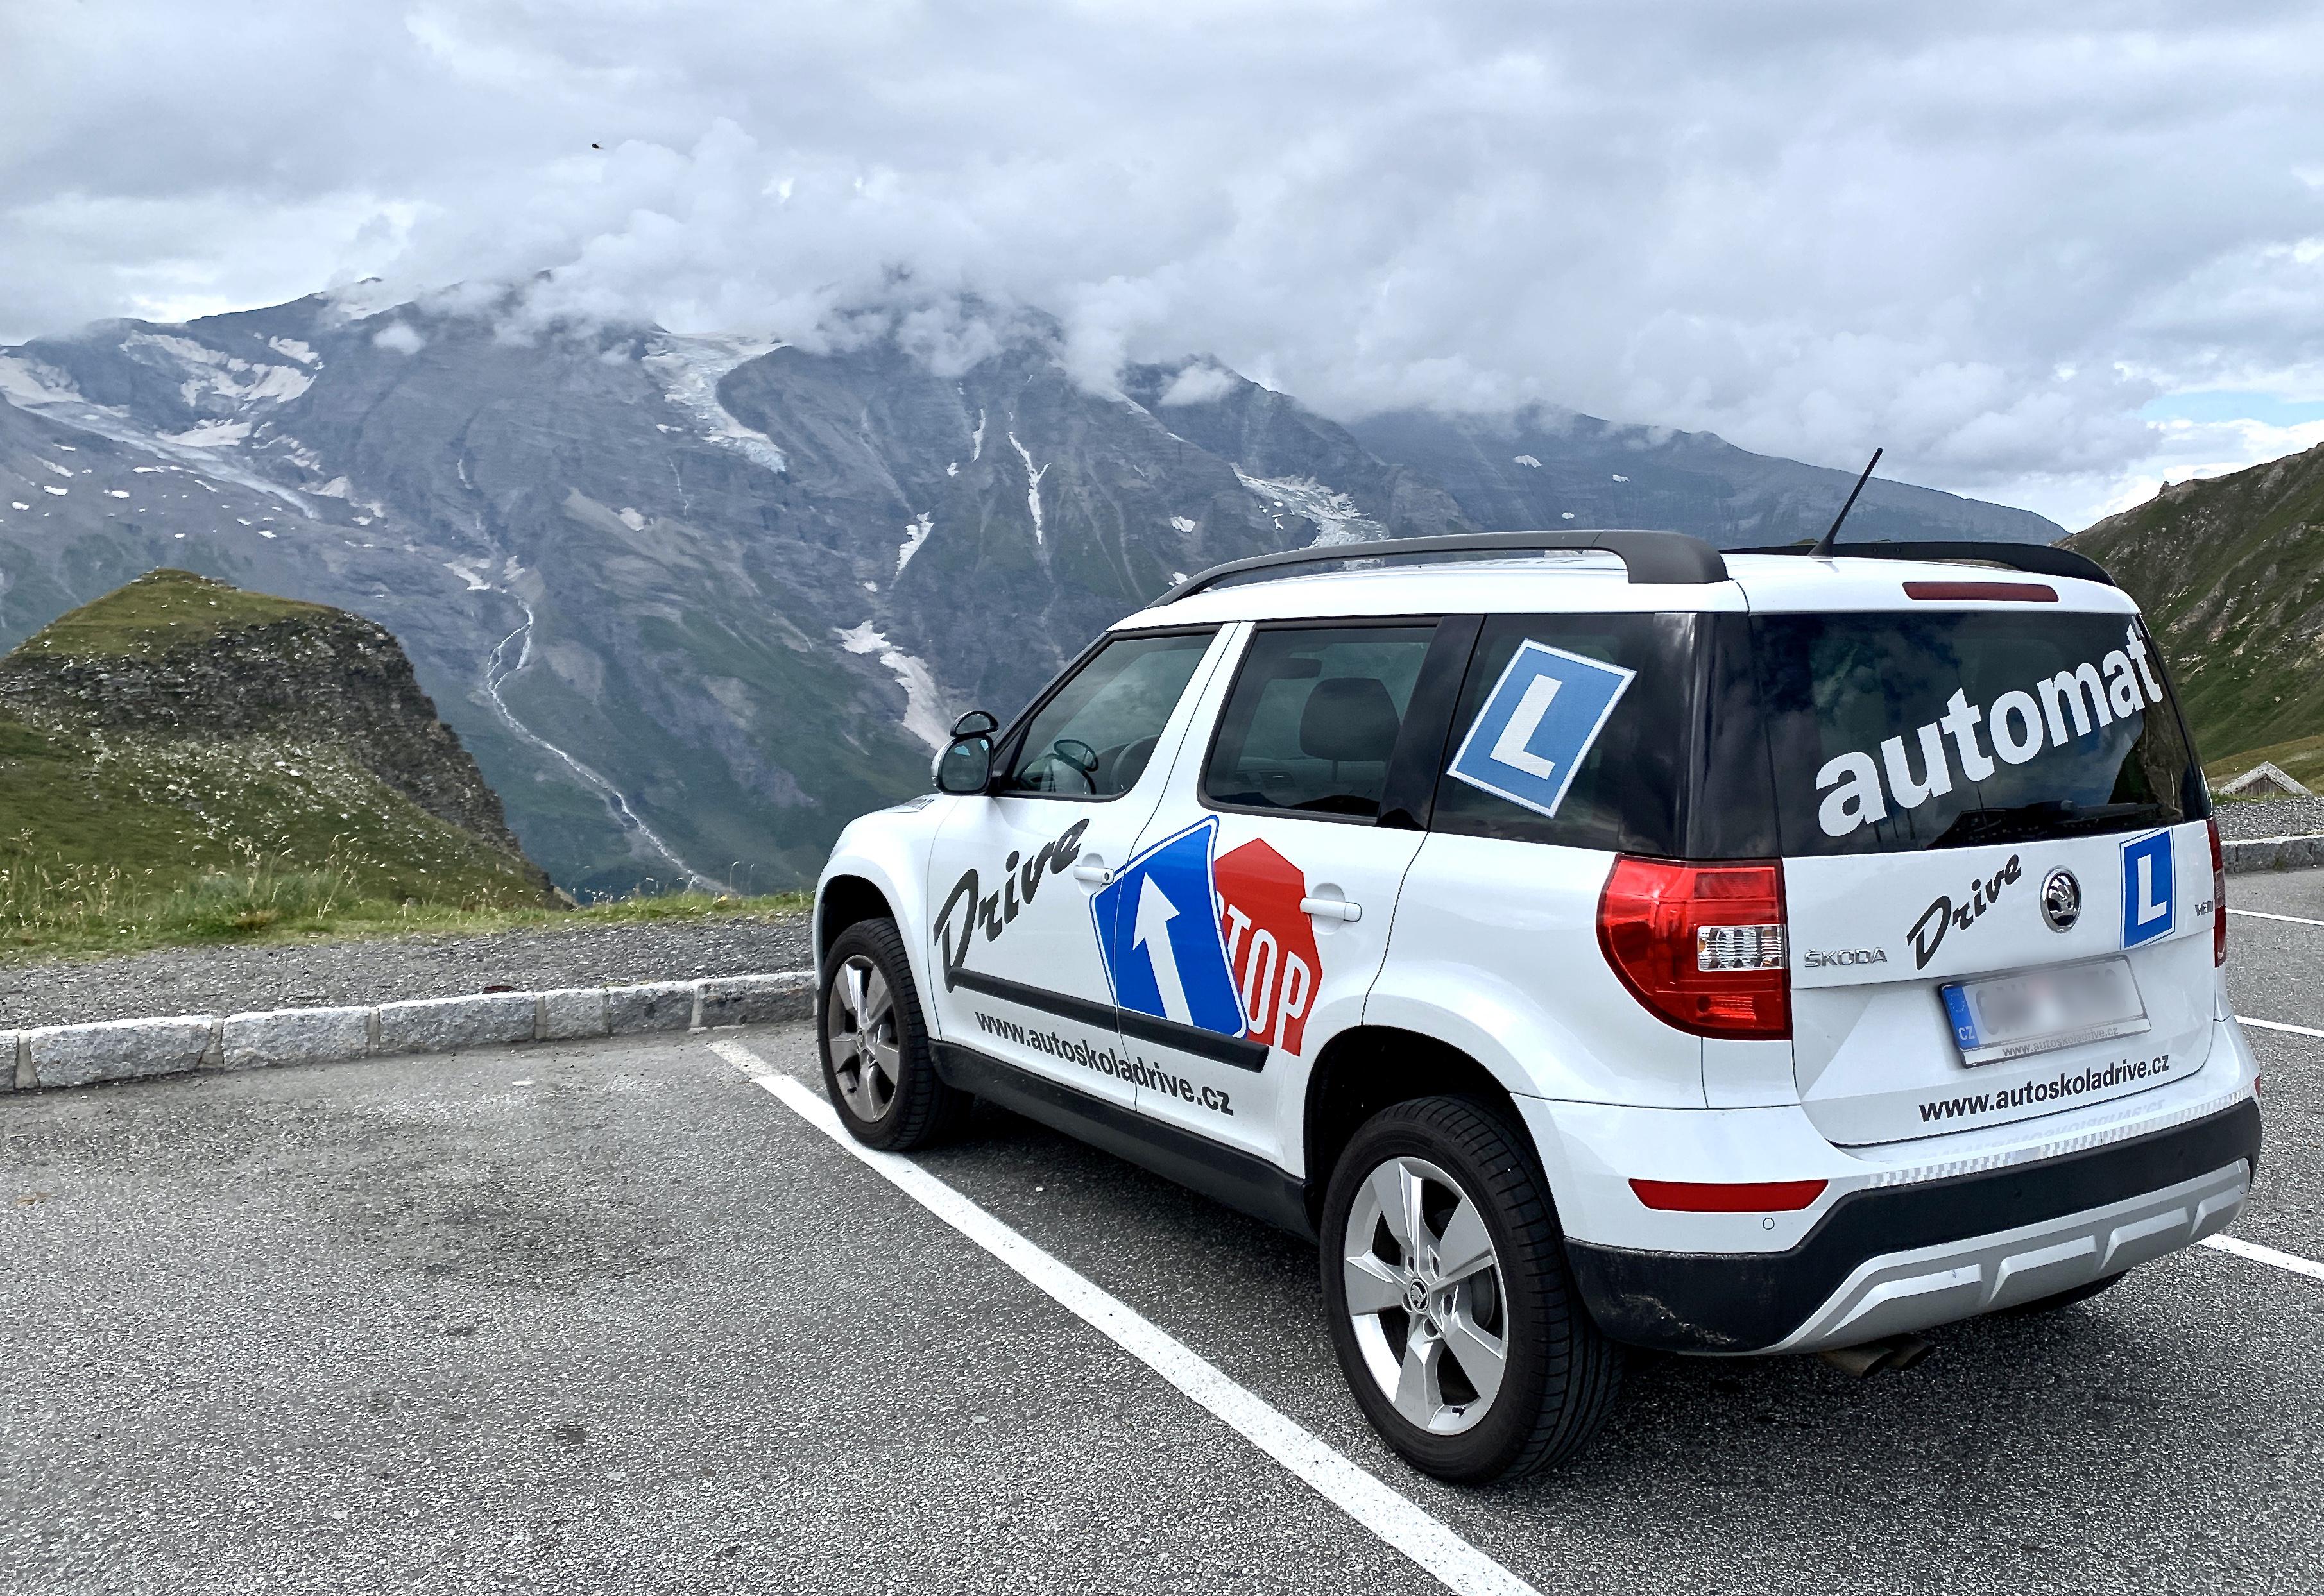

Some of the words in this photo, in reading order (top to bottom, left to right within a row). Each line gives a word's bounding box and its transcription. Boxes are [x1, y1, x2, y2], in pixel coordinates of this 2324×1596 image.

[1489, 673, 1563, 781] L
[1815, 623, 2164, 837] automat
[933, 818, 1089, 994] Drive
[1906, 854, 2022, 971] Drive
[2137, 854, 2168, 926] L
[1217, 890, 1311, 1049] TOP
[1804, 947, 1888, 968] ŠKODA
[974, 1010, 1234, 1116] www.autoskoladrive.cz
[1958, 1026, 1975, 1041] CZ
[2002, 1026, 2119, 1057] www.autoskoladrive.cz
[1919, 1054, 2170, 1123] www.autoskoladrive.cz
